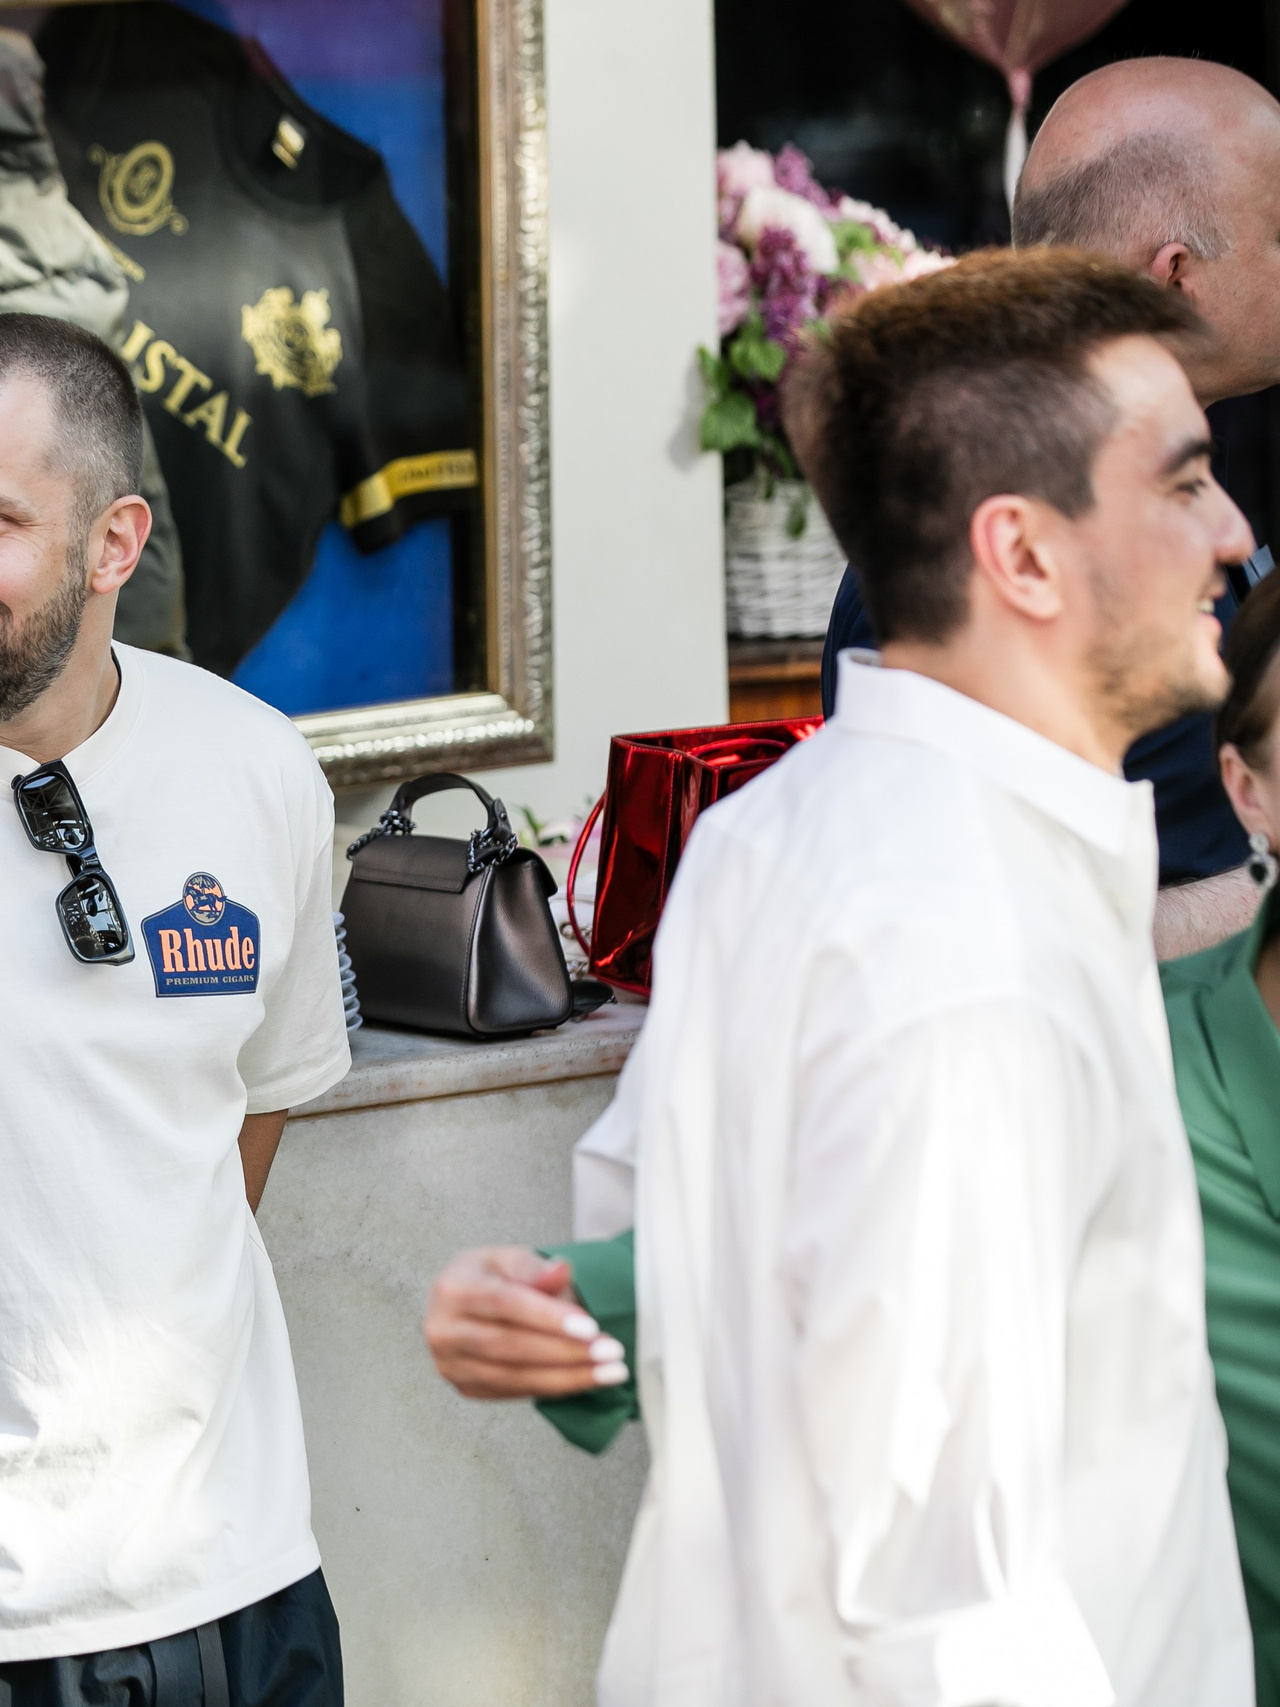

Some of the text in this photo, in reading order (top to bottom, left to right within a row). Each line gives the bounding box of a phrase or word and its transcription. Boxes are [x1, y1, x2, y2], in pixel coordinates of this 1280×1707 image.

[158, 926, 255, 973] Rhude
[165, 974, 255, 986] PREMIUM CIGARS
